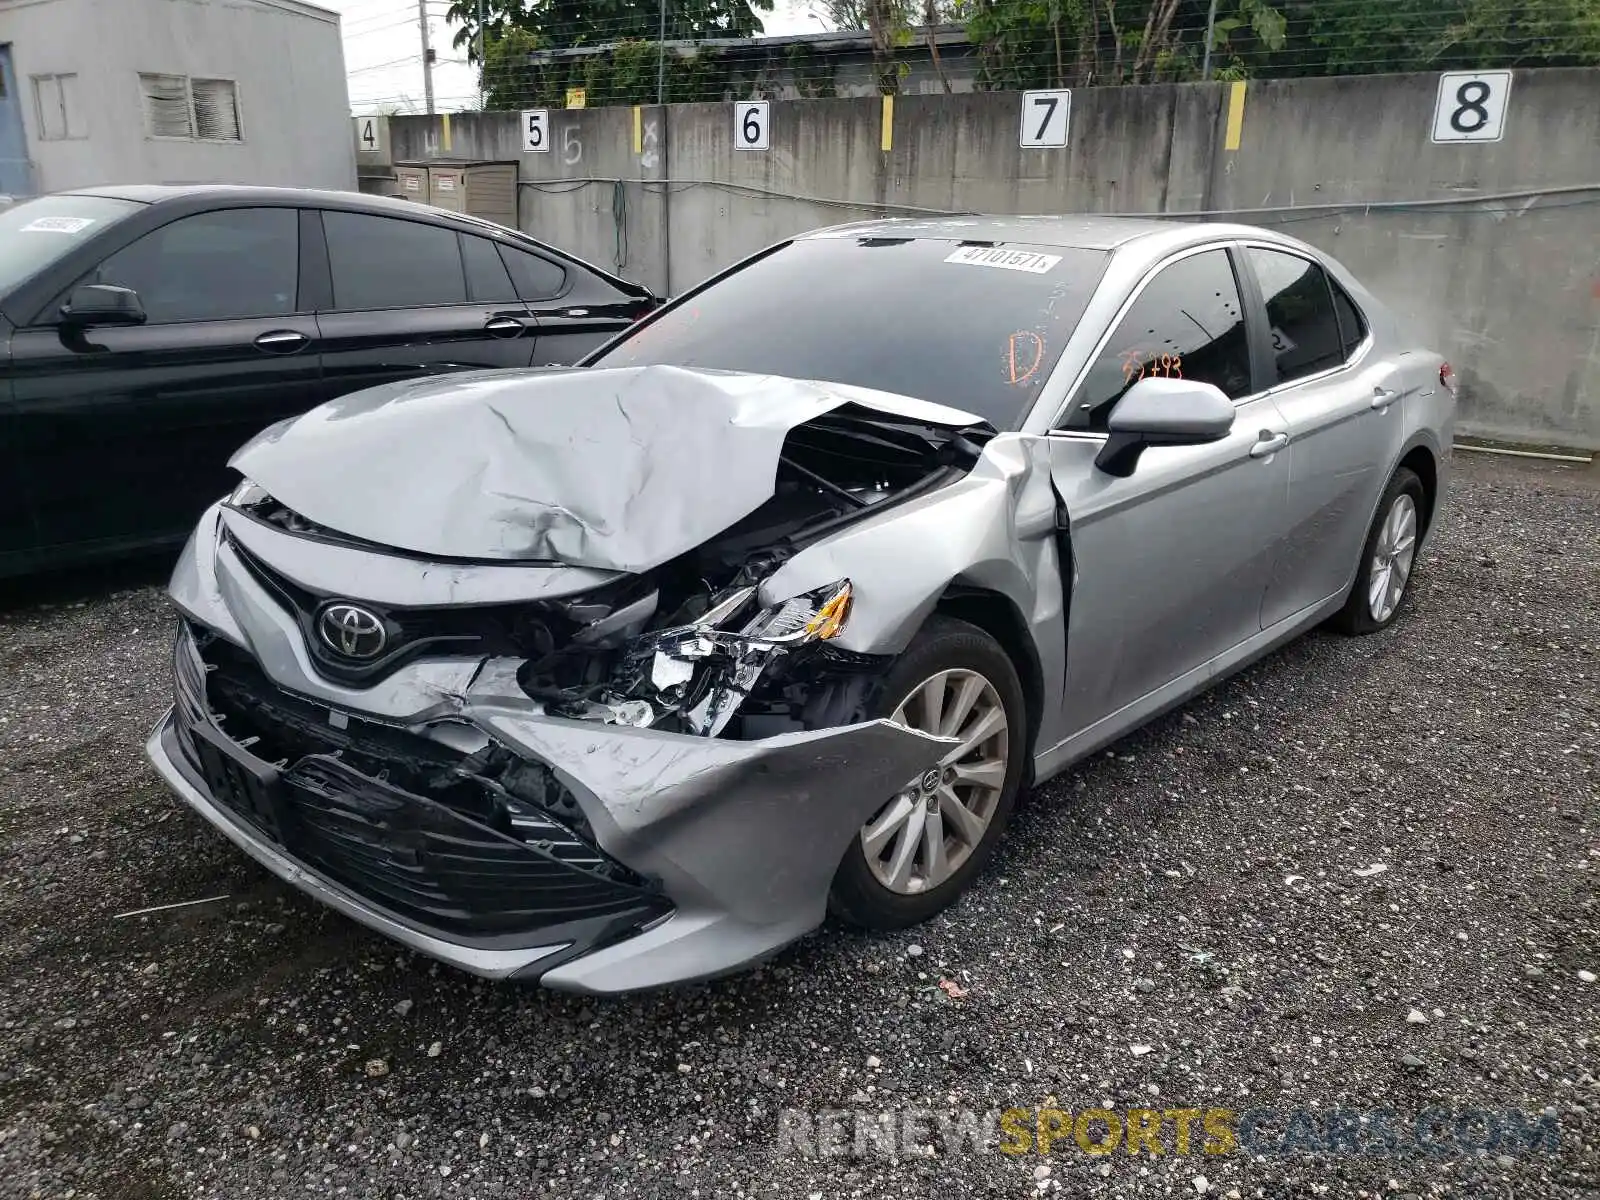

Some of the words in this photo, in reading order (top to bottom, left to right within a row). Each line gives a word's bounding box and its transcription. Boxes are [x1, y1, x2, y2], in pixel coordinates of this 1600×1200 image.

[743, 107, 760, 144] 6
[1034, 97, 1059, 140] 7
[1451, 81, 1491, 133] 8
[363, 120, 375, 147] 4
[529, 115, 542, 147] 5
[564, 125, 582, 165] 5
[1008, 332, 1043, 384] D
